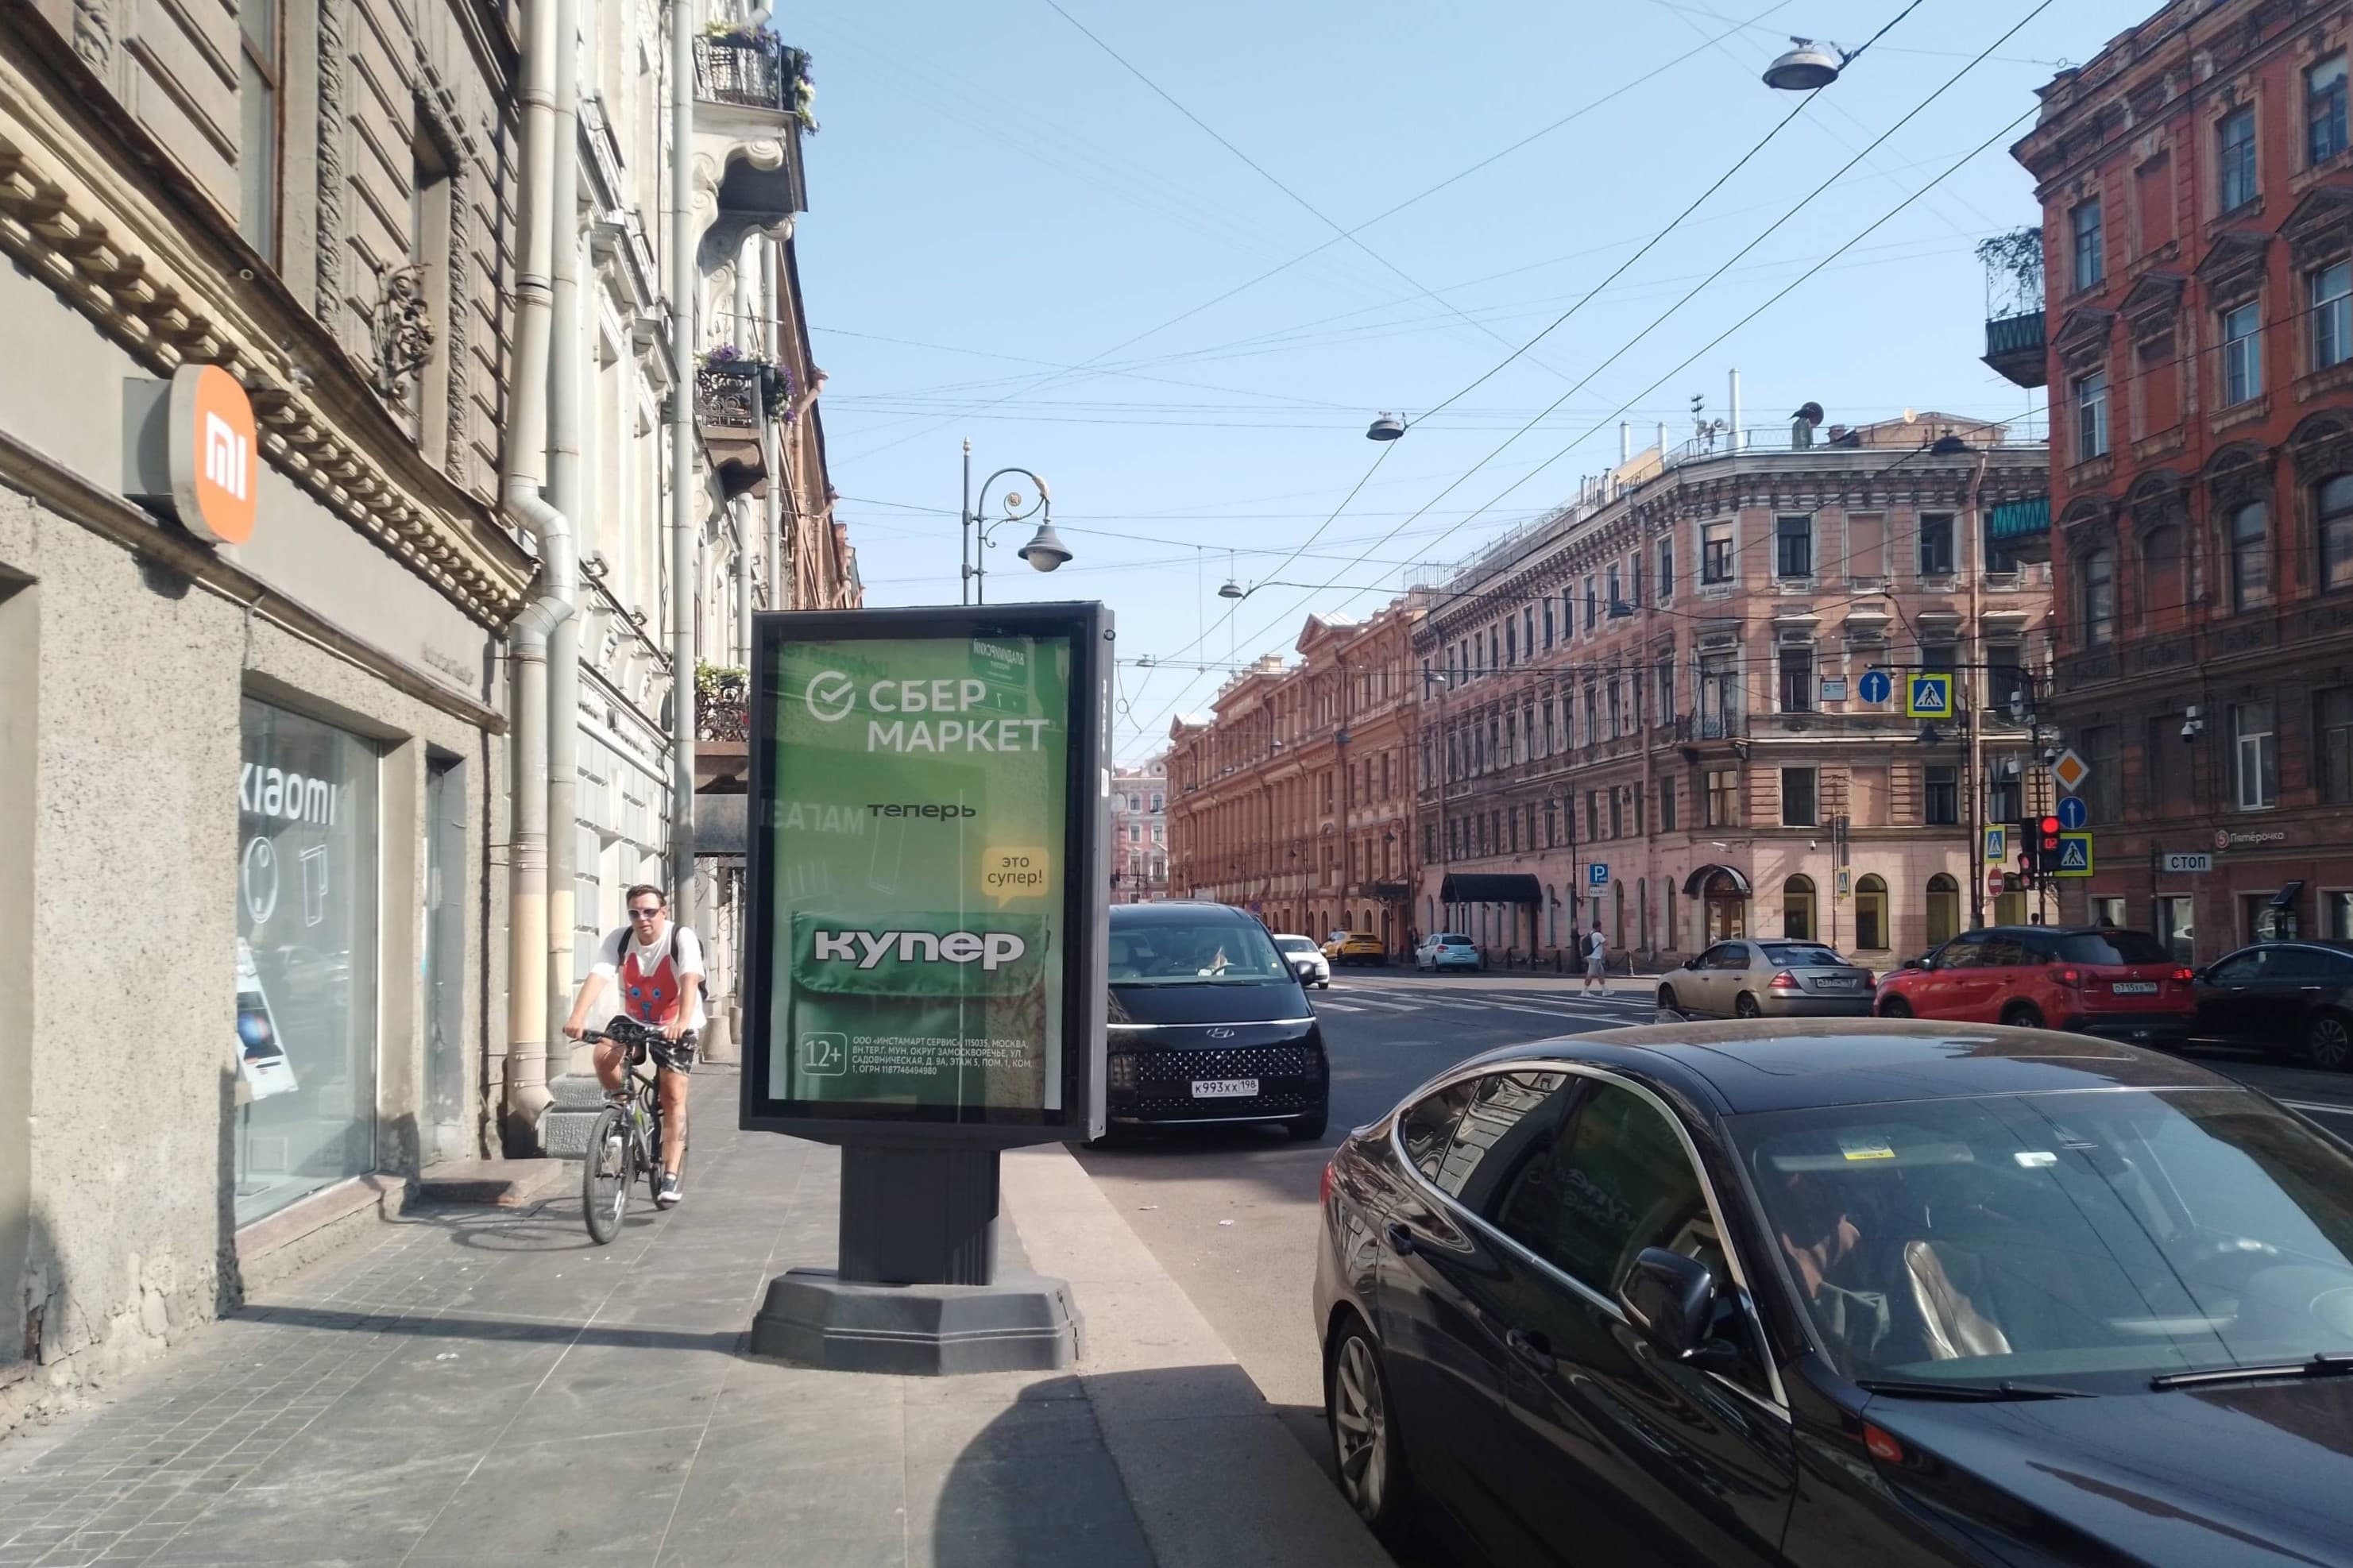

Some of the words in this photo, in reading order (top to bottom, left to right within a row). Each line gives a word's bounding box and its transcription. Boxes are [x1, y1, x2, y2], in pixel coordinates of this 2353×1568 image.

[869, 679, 987, 713] СБЕР
[867, 719, 1049, 753] МАРКЕТ
[867, 803, 976, 821] теперь
[2230, 831, 2284, 844] Пятёрочка
[1002, 856, 1030, 868] это
[2171, 856, 2206, 869] СТОП
[987, 869, 1043, 886] супер!
[1594, 866, 1605, 882] P
[814, 930, 1026, 971] купер
[852, 1036, 871, 1045] ООО
[872, 1037, 925, 1045] «ИНСТАМАРТ
[991, 1039, 1029, 1049] МОСКВА,
[804, 1040, 842, 1068] 12+
[910, 1047, 937, 1056] ОКРУГ
[937, 1048, 1008, 1058] ЗАМОСКВОРЕЧЬЕ,
[1010, 1049, 1023, 1058] УЛ.
[852, 1055, 925, 1066] САДОВНИЧЕСКАЯ,
[949, 1057, 972, 1067] ЭТАЖ
[859, 1065, 880, 1074] ОГРН
